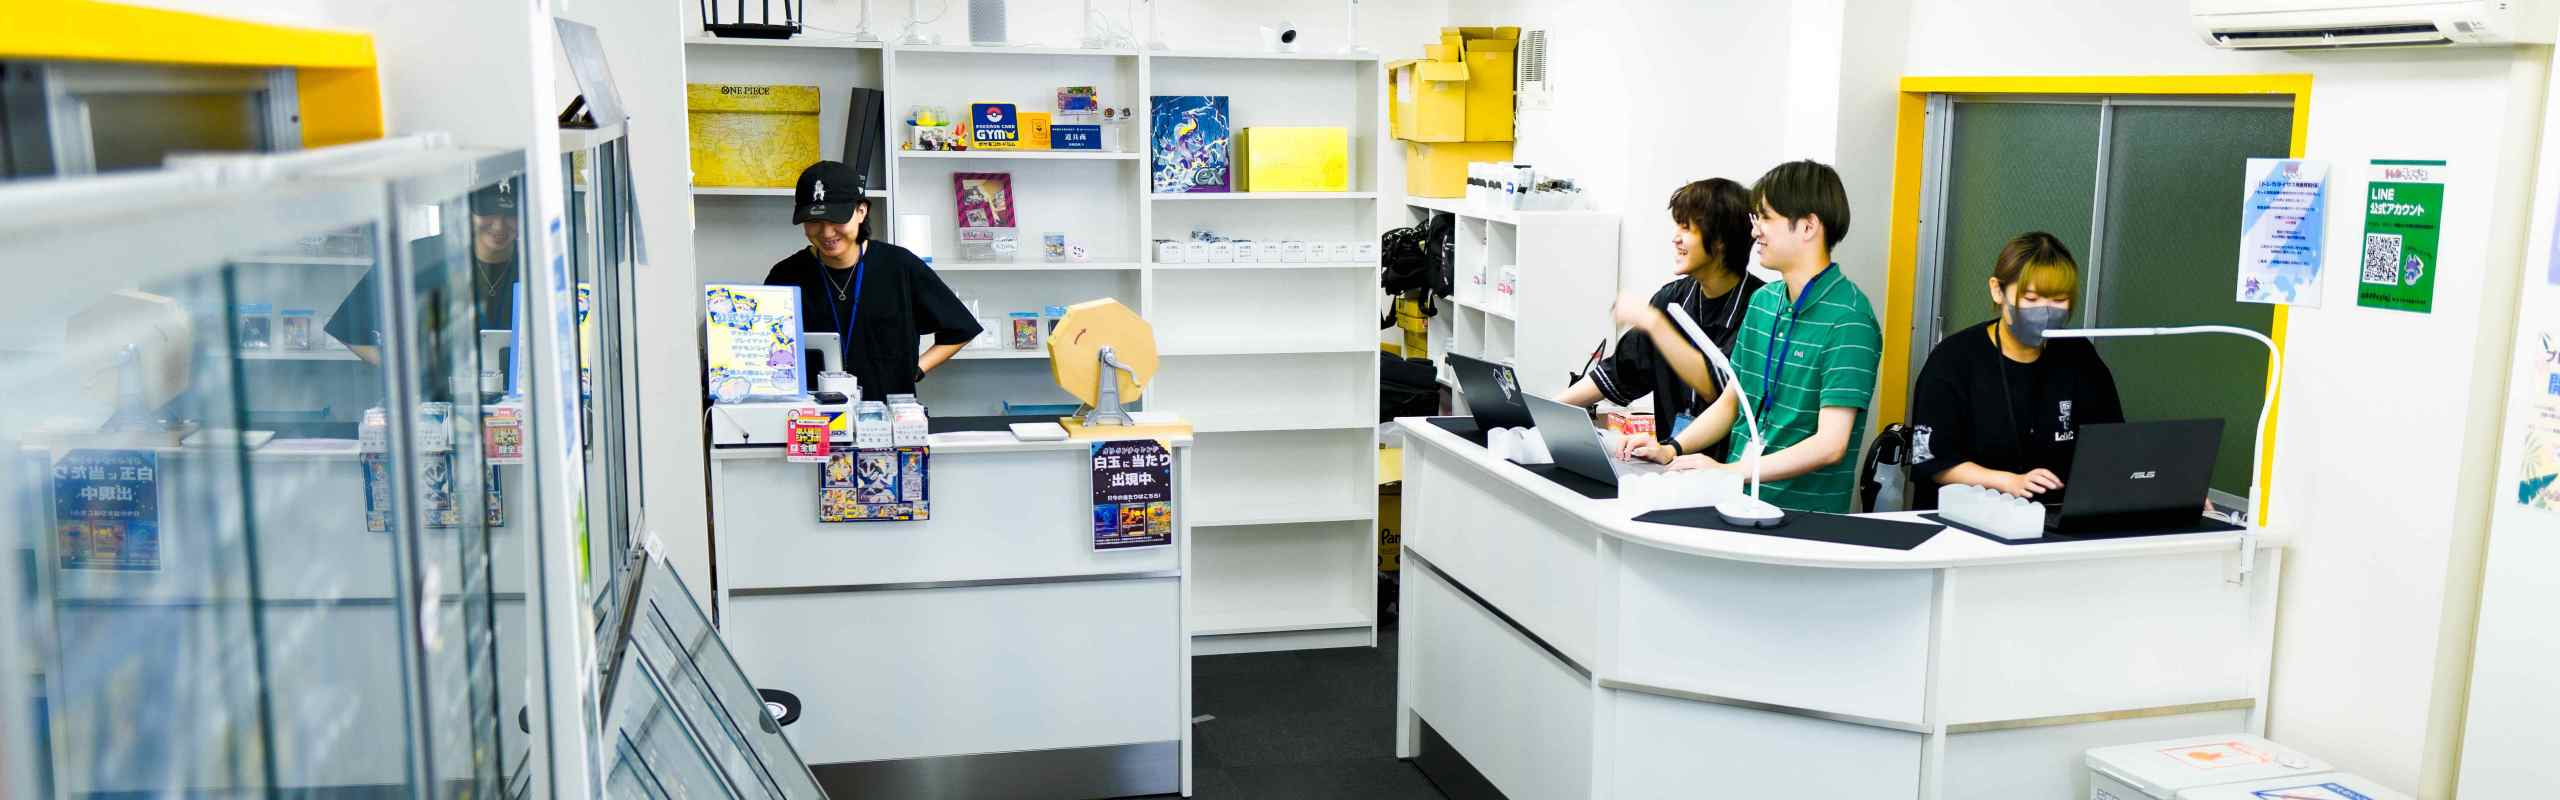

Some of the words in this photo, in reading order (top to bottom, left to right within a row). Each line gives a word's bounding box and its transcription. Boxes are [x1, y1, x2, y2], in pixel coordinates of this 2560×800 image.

[721, 86, 742, 95] ONE
[744, 86, 770, 95] PIECE
[976, 129, 1006, 140] GYM
[1195, 167, 1226, 186] ex
[2371, 188, 2395, 201] LINE
[2370, 202, 2425, 217] 公式アカウント
[1094, 454, 1171, 470] 白玉に当たり
[1112, 472, 1151, 487] 出現中
[2129, 471, 2156, 480] ASUS
